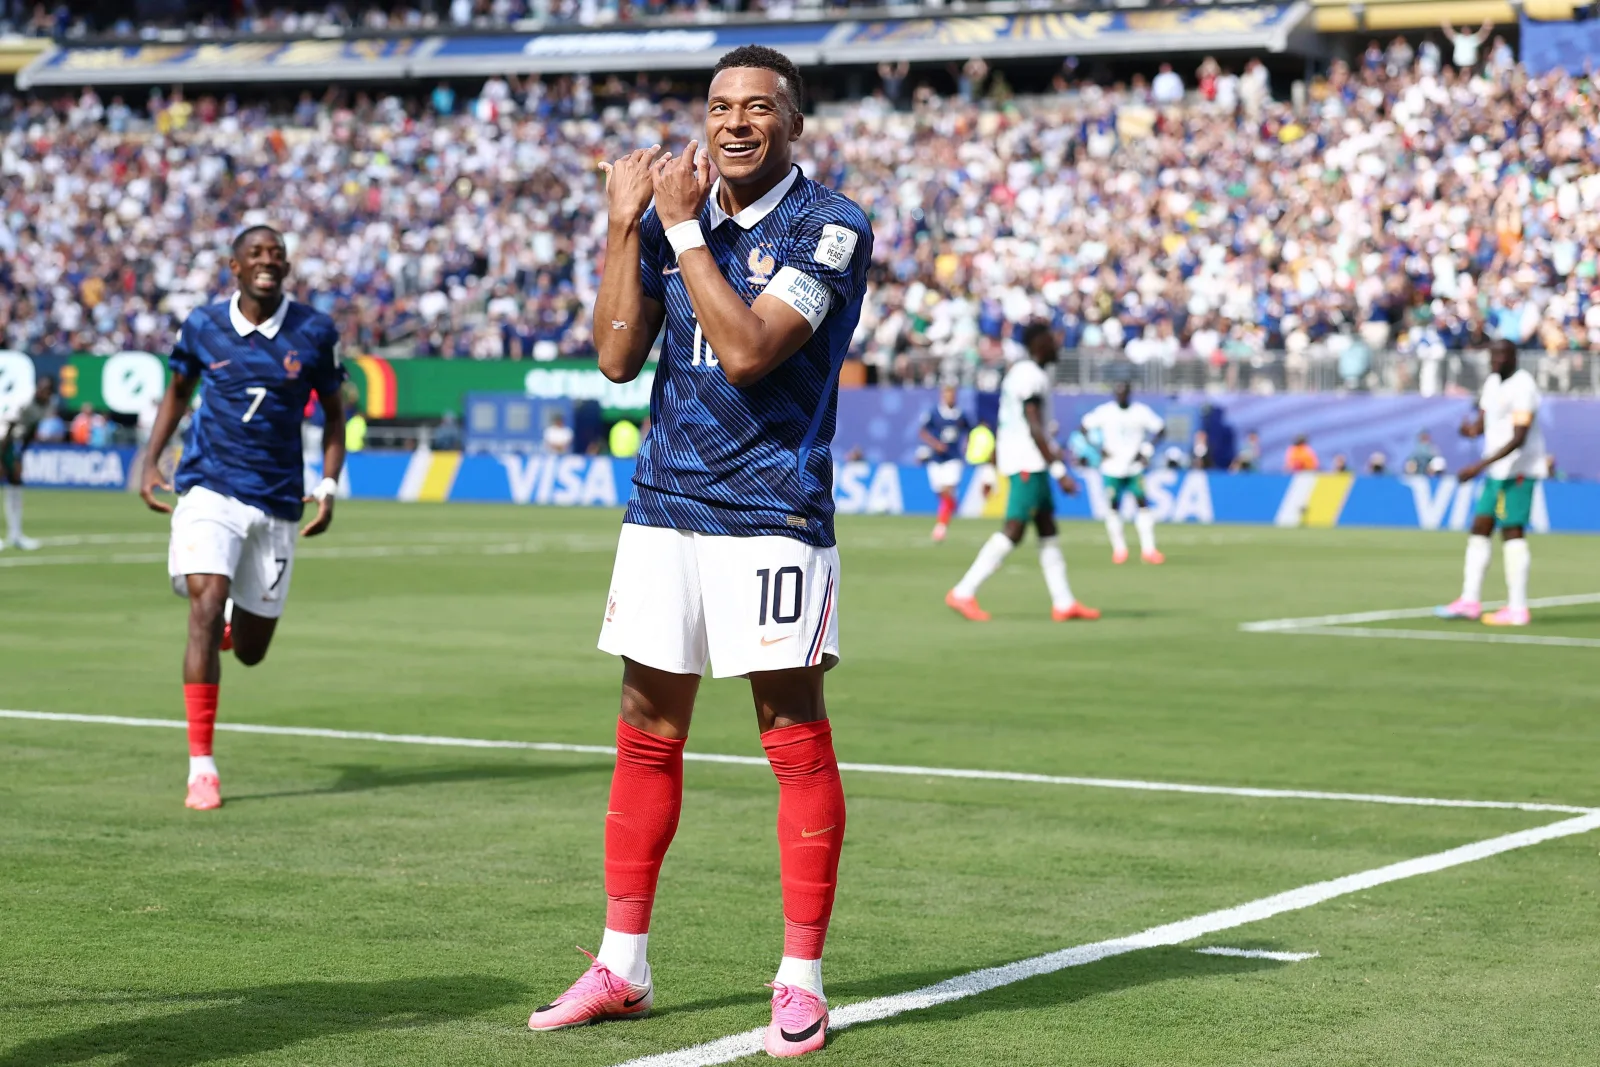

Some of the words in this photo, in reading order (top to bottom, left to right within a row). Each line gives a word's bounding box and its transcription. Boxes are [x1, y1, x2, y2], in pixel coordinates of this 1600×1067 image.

[827, 248, 843, 261] PEACE
[787, 285, 801, 297] the
[801, 294, 823, 317] World
[794, 276, 826, 307] UNITES
[799, 271, 828, 298] FOOTBALL
[795, 300, 809, 315] FIFA
[241, 387, 267, 423] 7
[22, 449, 123, 485] MERICA
[498, 455, 617, 505] VISA
[832, 462, 905, 515] SA
[1399, 475, 1550, 532] VI
[269, 558, 287, 591] 7
[757, 565, 803, 626] 10
